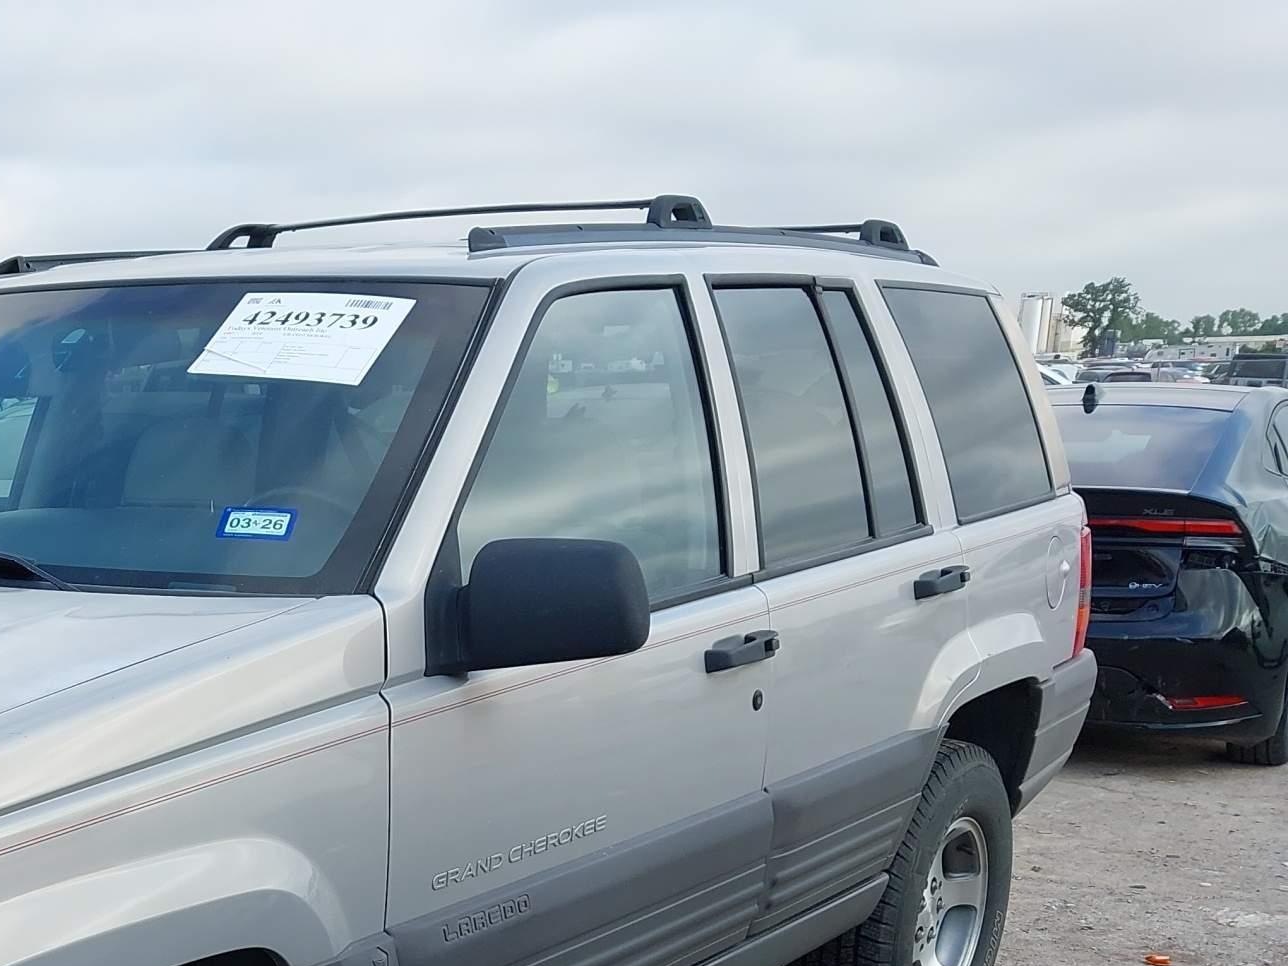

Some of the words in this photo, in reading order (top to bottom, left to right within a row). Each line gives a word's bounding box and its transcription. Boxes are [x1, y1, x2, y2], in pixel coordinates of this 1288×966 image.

[242, 310, 379, 330] 42493739
[229, 517, 252, 529] 03
[260, 518, 285, 530] 26
[431, 853, 504, 891] GRAND
[507, 814, 608, 864] CHEROKEE
[442, 893, 532, 943] LAREDO
